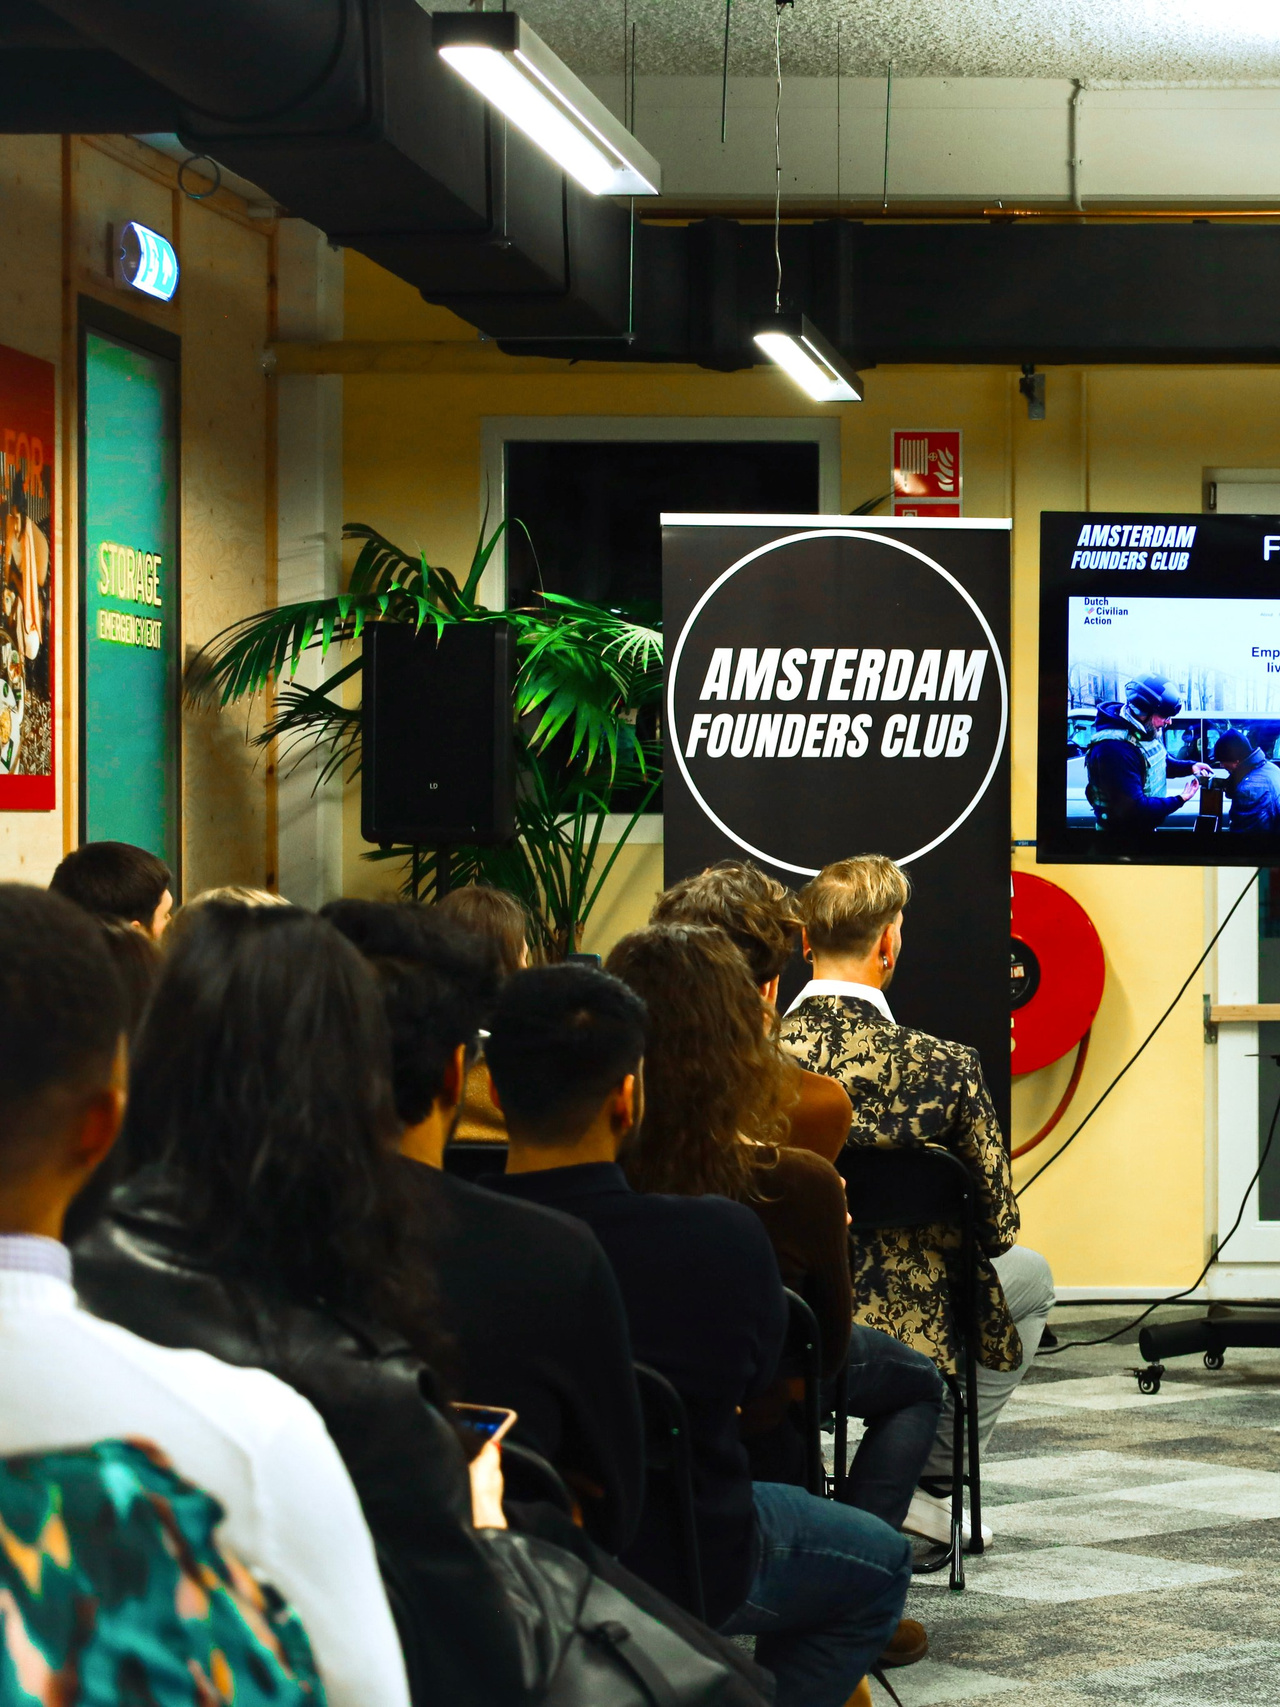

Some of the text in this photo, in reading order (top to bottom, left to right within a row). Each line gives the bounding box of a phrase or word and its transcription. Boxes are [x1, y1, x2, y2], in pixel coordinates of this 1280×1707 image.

[4, 428, 44, 498] FOR
[1077, 525, 1196, 548] AMSTERDAM
[100, 542, 162, 606] STORAGE
[1071, 551, 1190, 570] FOUNDERS CLUB
[1084, 597, 1109, 606] Dutch
[1096, 607, 1128, 616] Civilian
[100, 610, 162, 648] EMERGENCY EXIT
[1084, 616, 1112, 625] Action
[699, 648, 988, 701] AMSTERDAM
[686, 714, 973, 758] FOUNDERS CLUB
